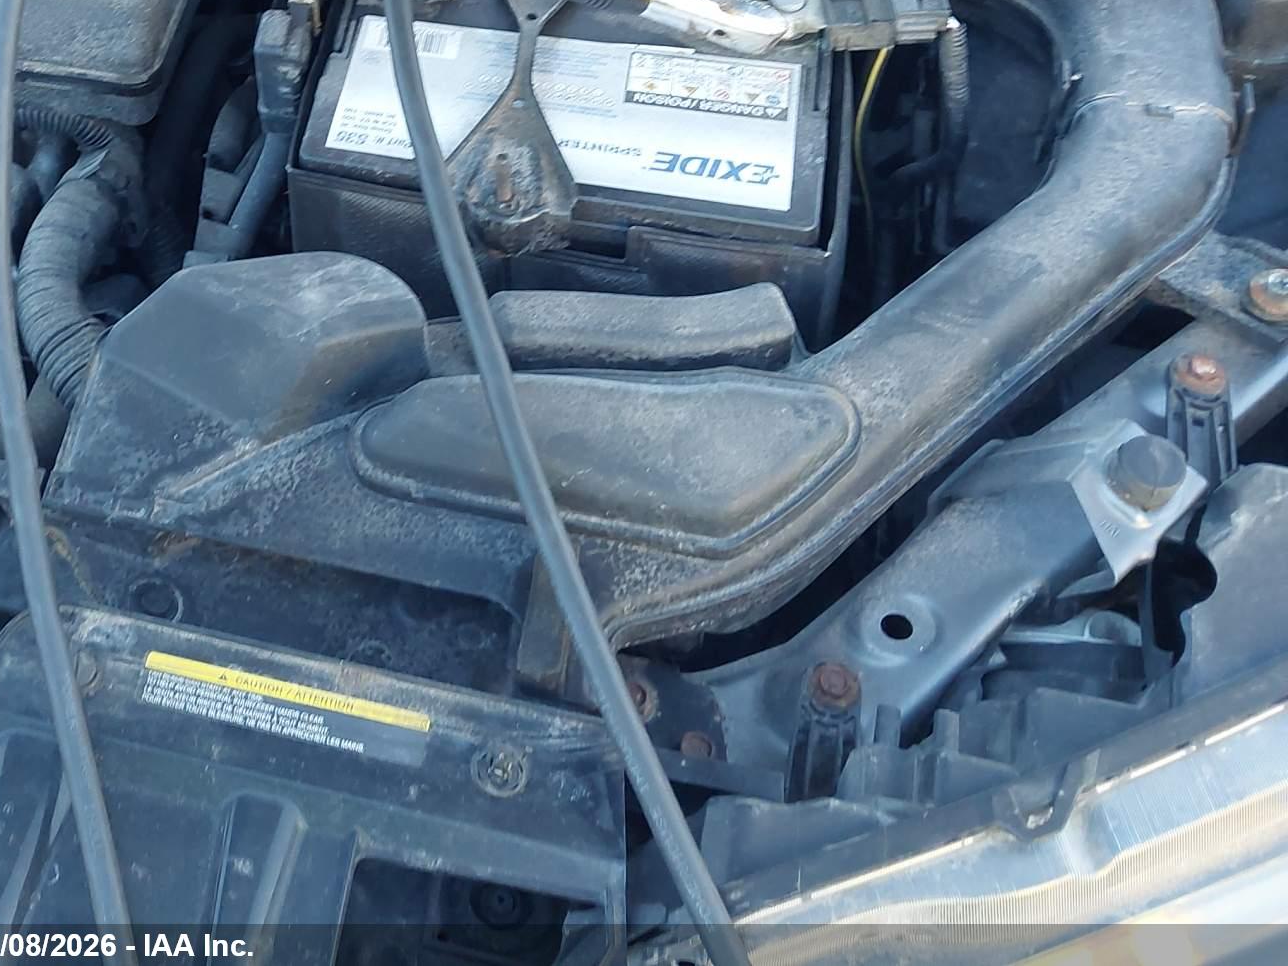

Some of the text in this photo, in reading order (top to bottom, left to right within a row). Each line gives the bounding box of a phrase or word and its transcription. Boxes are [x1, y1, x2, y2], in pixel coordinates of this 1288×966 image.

[632, 92, 691, 109] POISON
[699, 99, 765, 117] DANGER
[558, 138, 780, 185] EXIDE SPRINTER
[235, 676, 284, 695] CAUTION
[293, 690, 355, 712] ATTENTION
